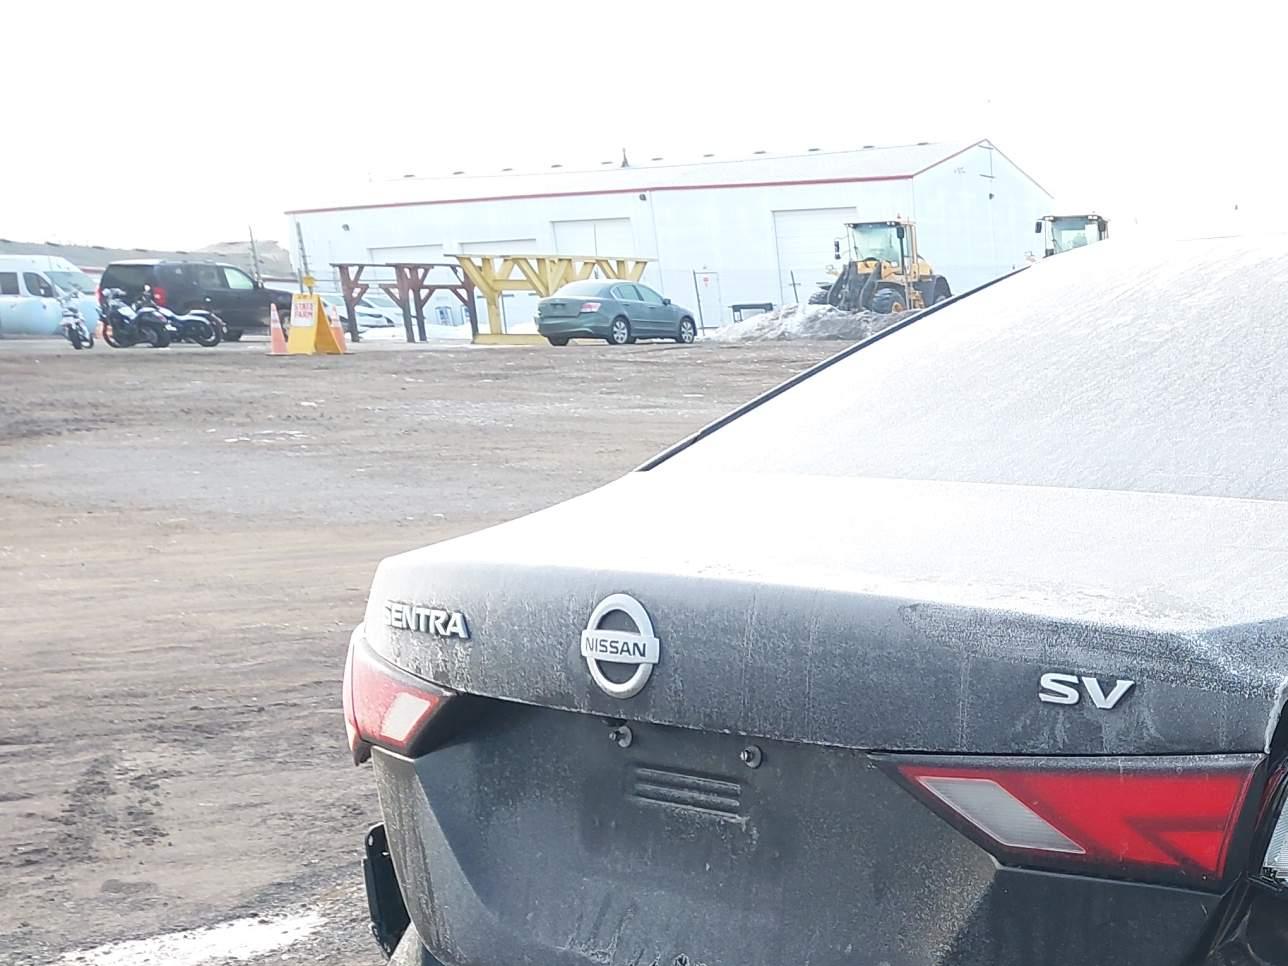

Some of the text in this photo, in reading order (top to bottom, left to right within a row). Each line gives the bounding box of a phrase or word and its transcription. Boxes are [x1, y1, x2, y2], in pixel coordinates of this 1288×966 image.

[383, 602, 471, 639] SENTRA
[585, 637, 646, 658] NISSAN
[1038, 672, 1135, 709] SV
